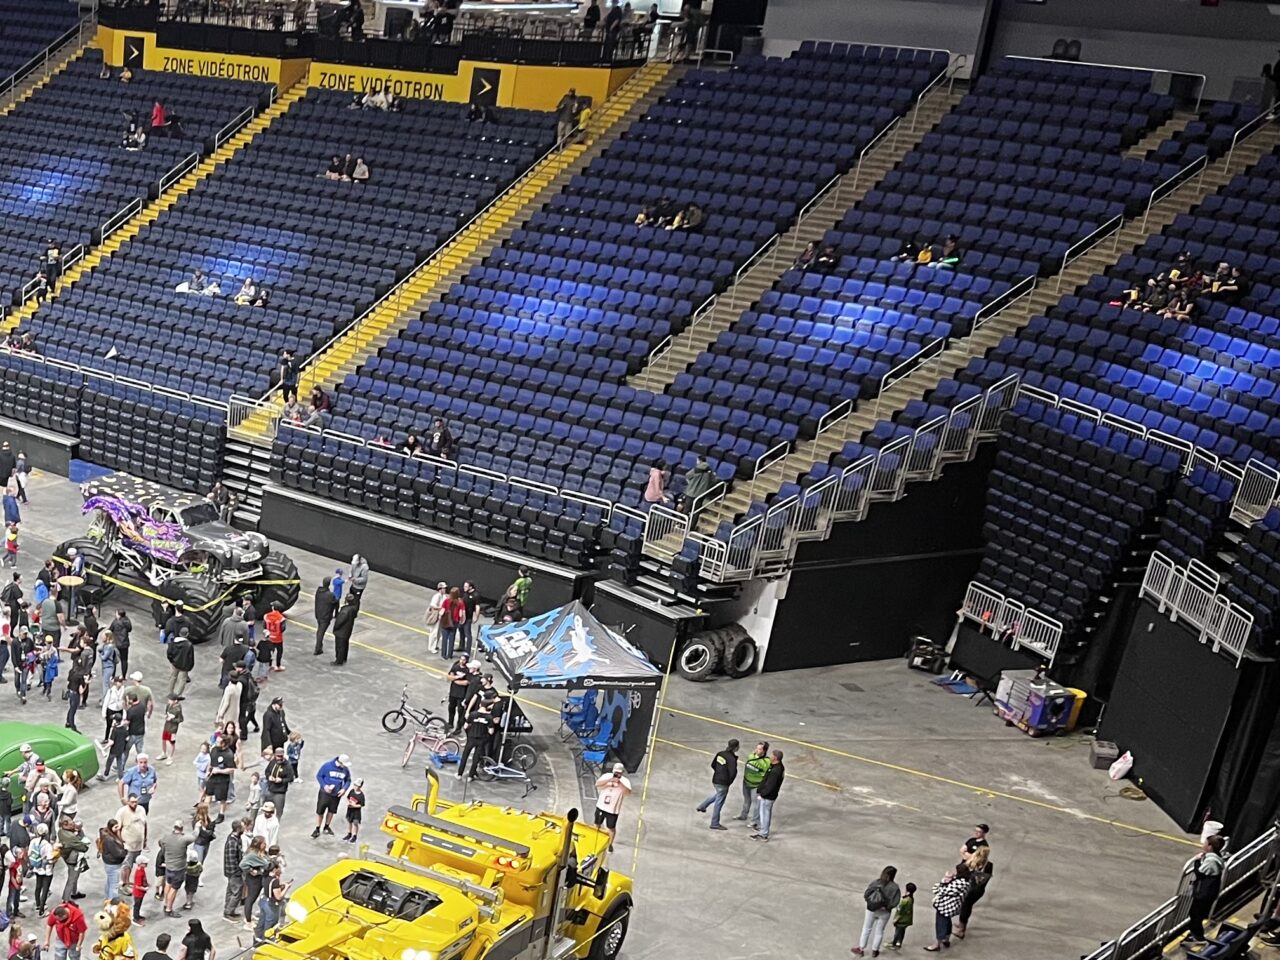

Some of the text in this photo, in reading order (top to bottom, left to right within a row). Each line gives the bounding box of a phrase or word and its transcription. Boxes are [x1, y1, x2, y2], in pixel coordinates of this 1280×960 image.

[163, 57, 269, 82] ZONE VIDÉOTRON
[319, 72, 444, 100] ZONE VIDÉOTRON
